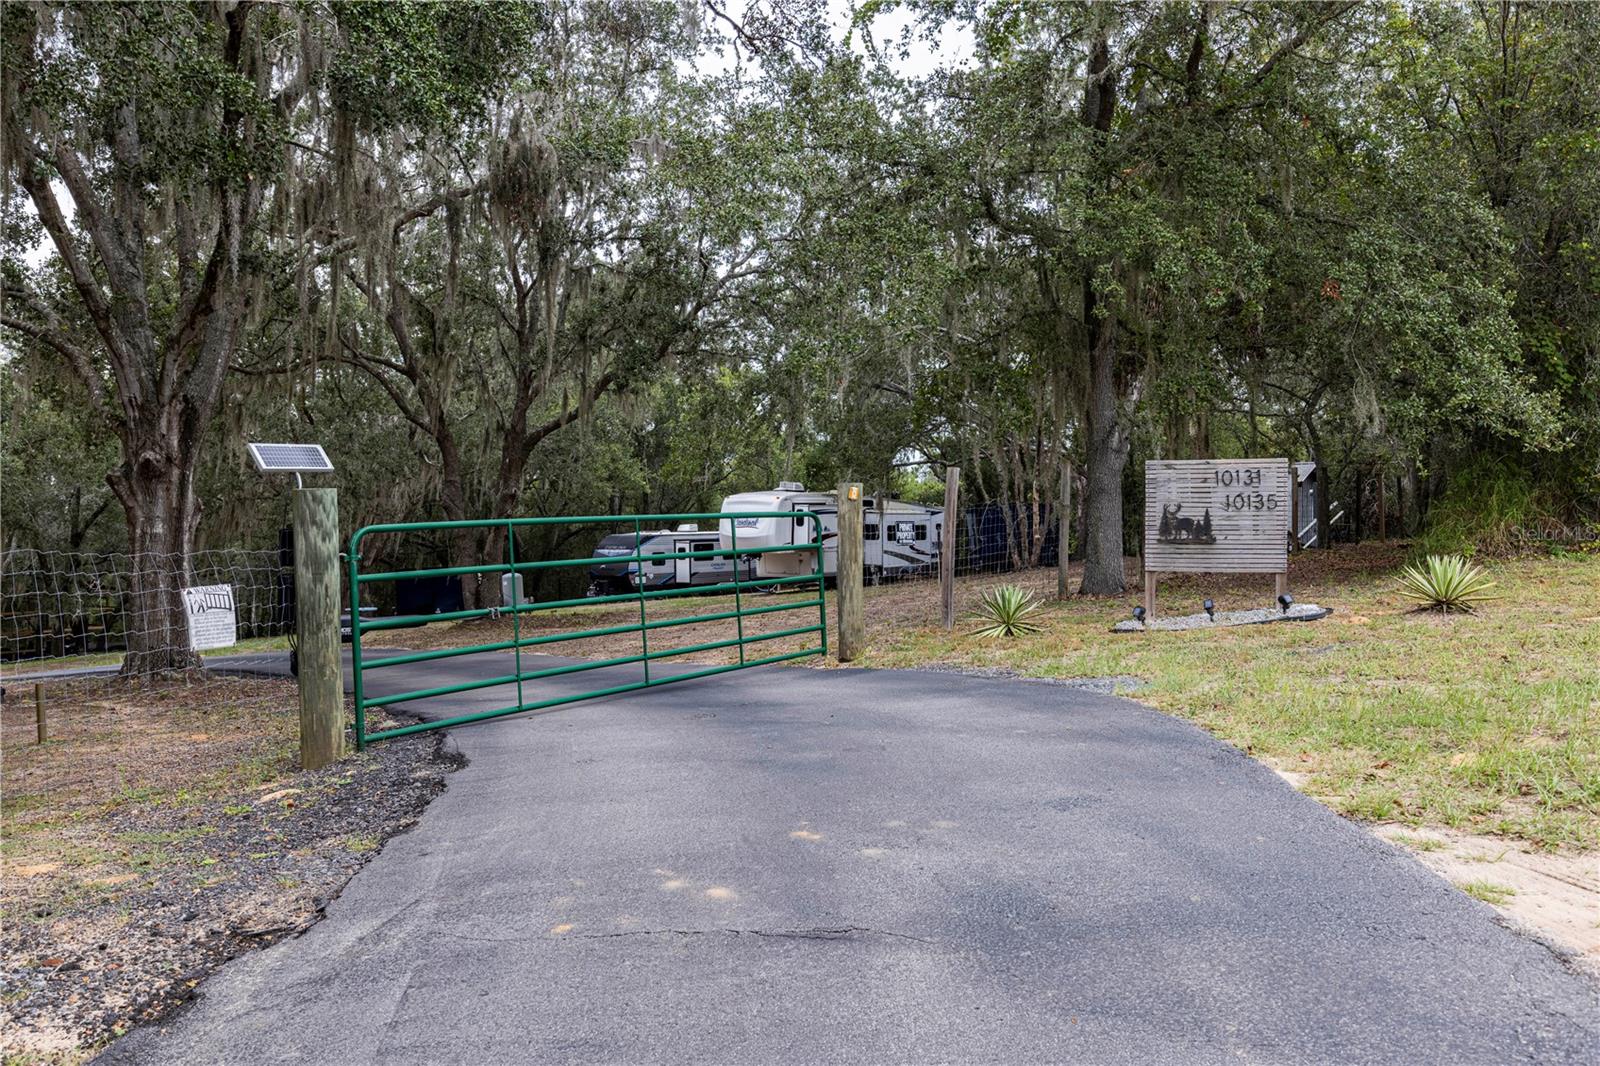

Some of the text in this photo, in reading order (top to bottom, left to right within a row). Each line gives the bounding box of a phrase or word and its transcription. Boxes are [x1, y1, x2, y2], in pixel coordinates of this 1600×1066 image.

[1214, 469, 1261, 486] 10131
[1225, 493, 1277, 510] 10135
[194, 585, 227, 593] WARNING
